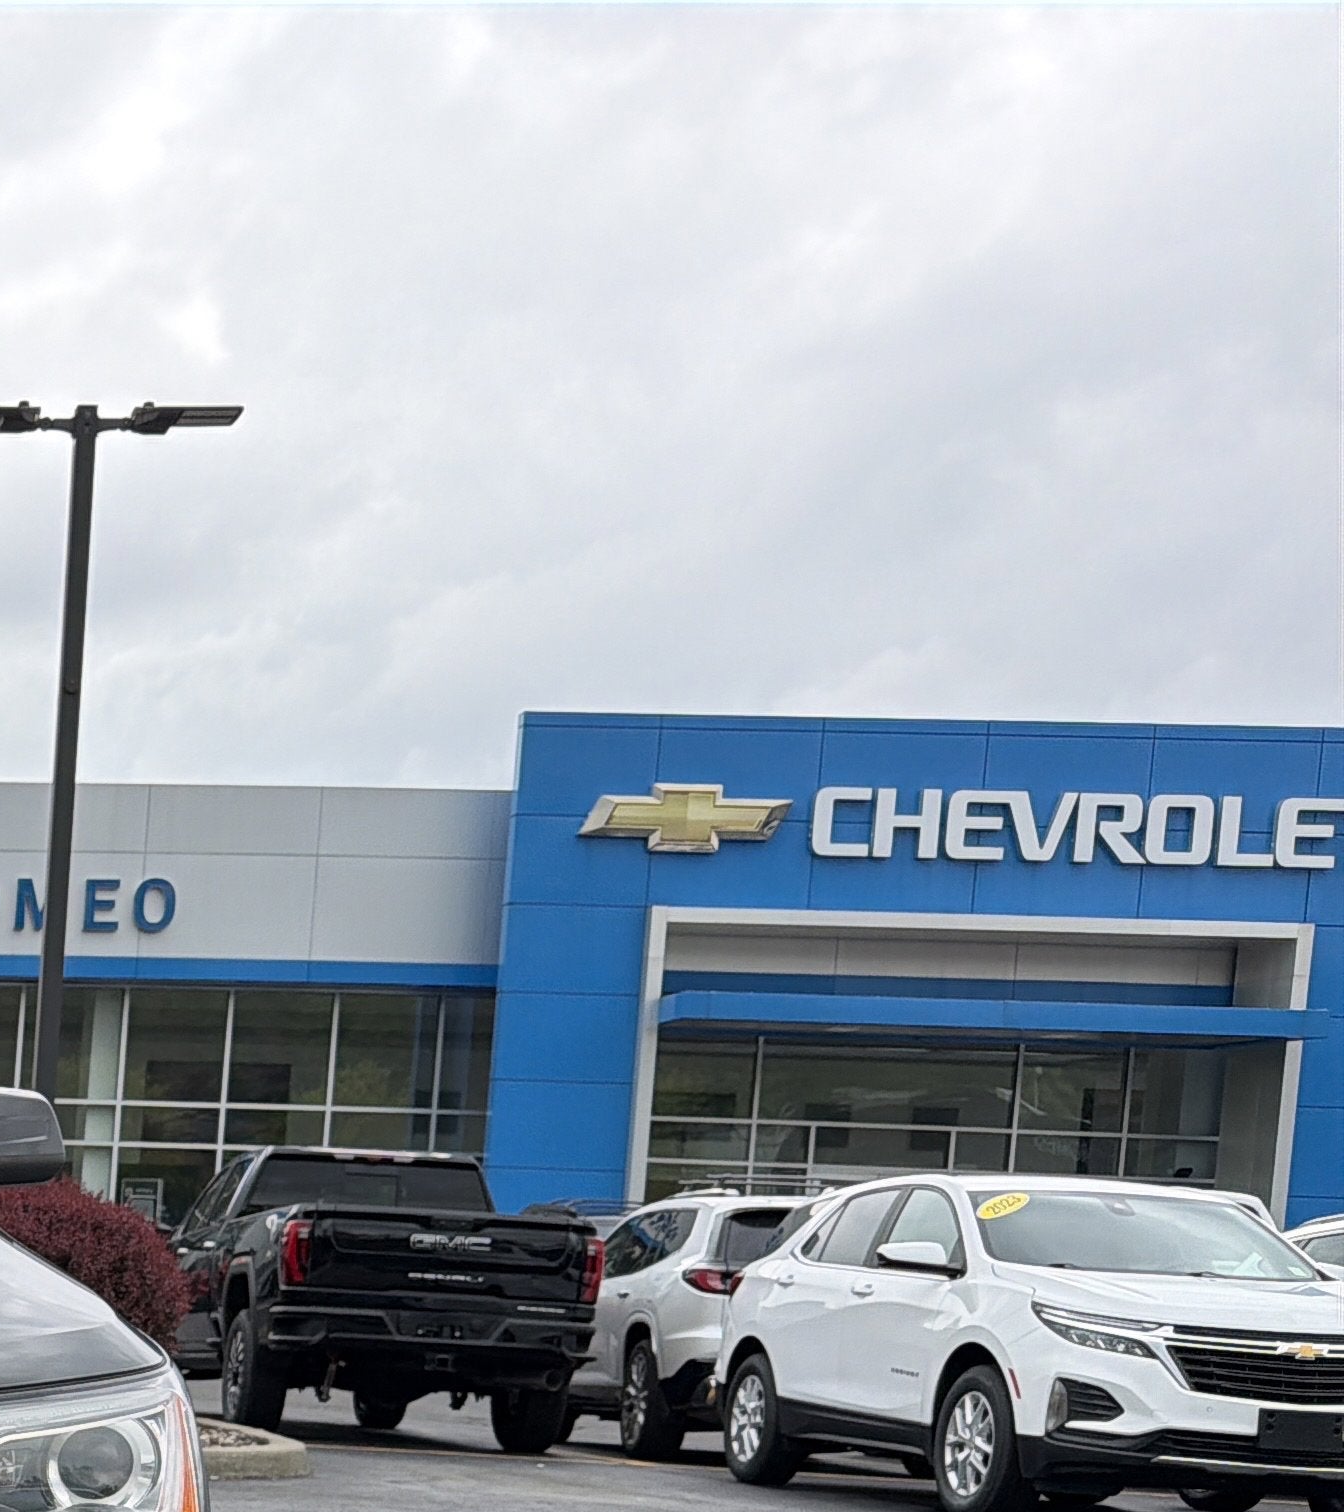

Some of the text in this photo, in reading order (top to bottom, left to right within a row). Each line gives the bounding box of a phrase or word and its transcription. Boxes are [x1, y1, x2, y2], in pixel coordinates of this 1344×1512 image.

[812, 786, 1344, 869] CHEVROLE
[985, 1195, 1021, 1215] 2023
[409, 1233, 493, 1251] GMC
